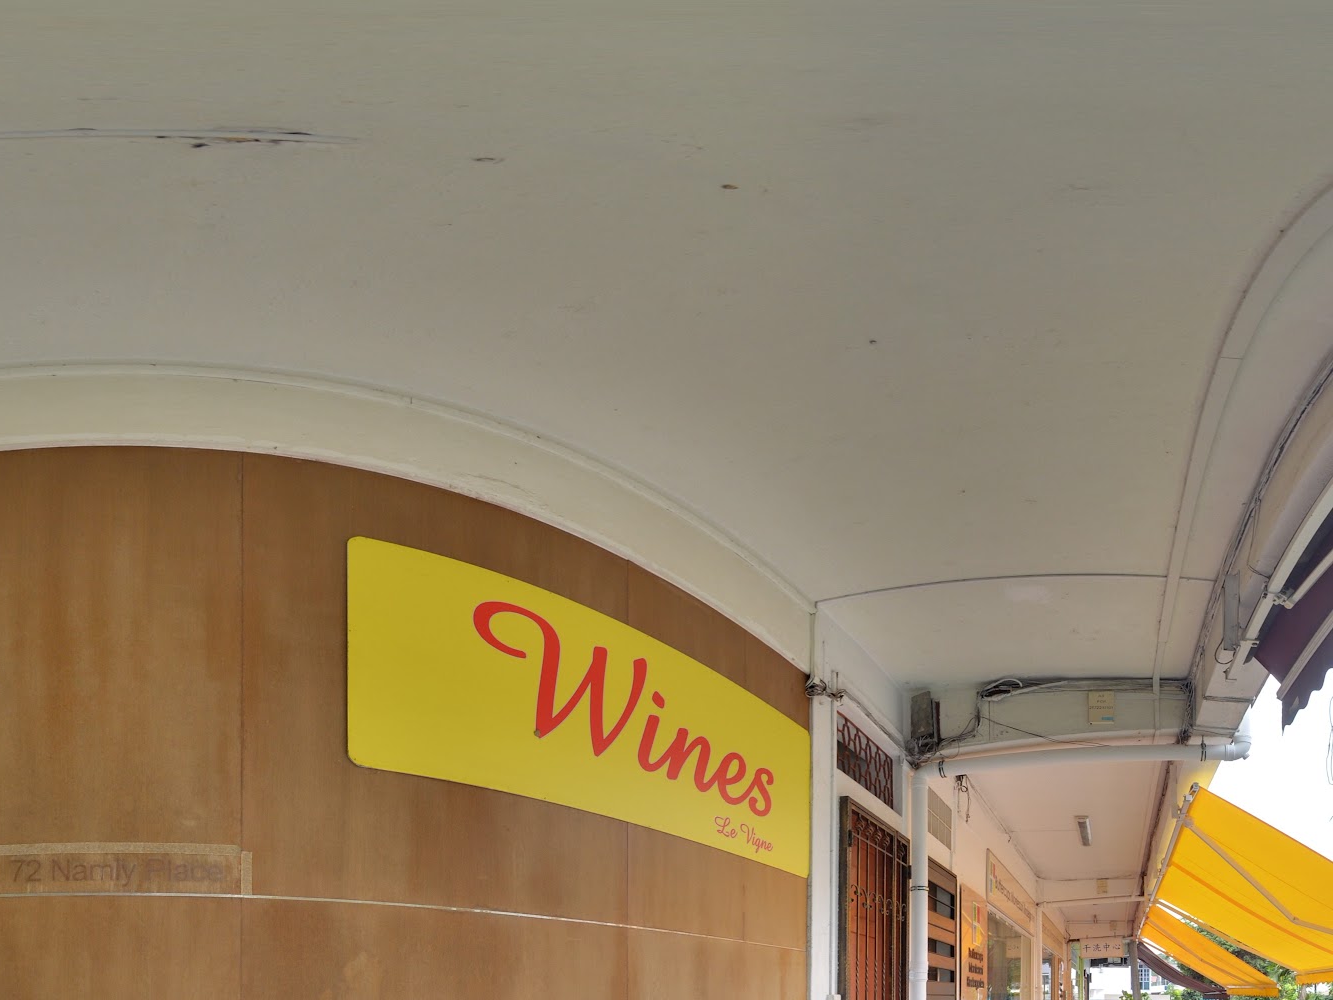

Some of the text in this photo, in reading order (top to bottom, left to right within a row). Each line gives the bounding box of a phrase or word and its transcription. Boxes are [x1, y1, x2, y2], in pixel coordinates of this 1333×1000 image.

[473, 600, 775, 817] Wines
[714, 816, 773, 853] Le Vigne
[12, 859, 41, 883] 72
[52, 858, 137, 887] Namly
[147, 858, 225, 883] Place
